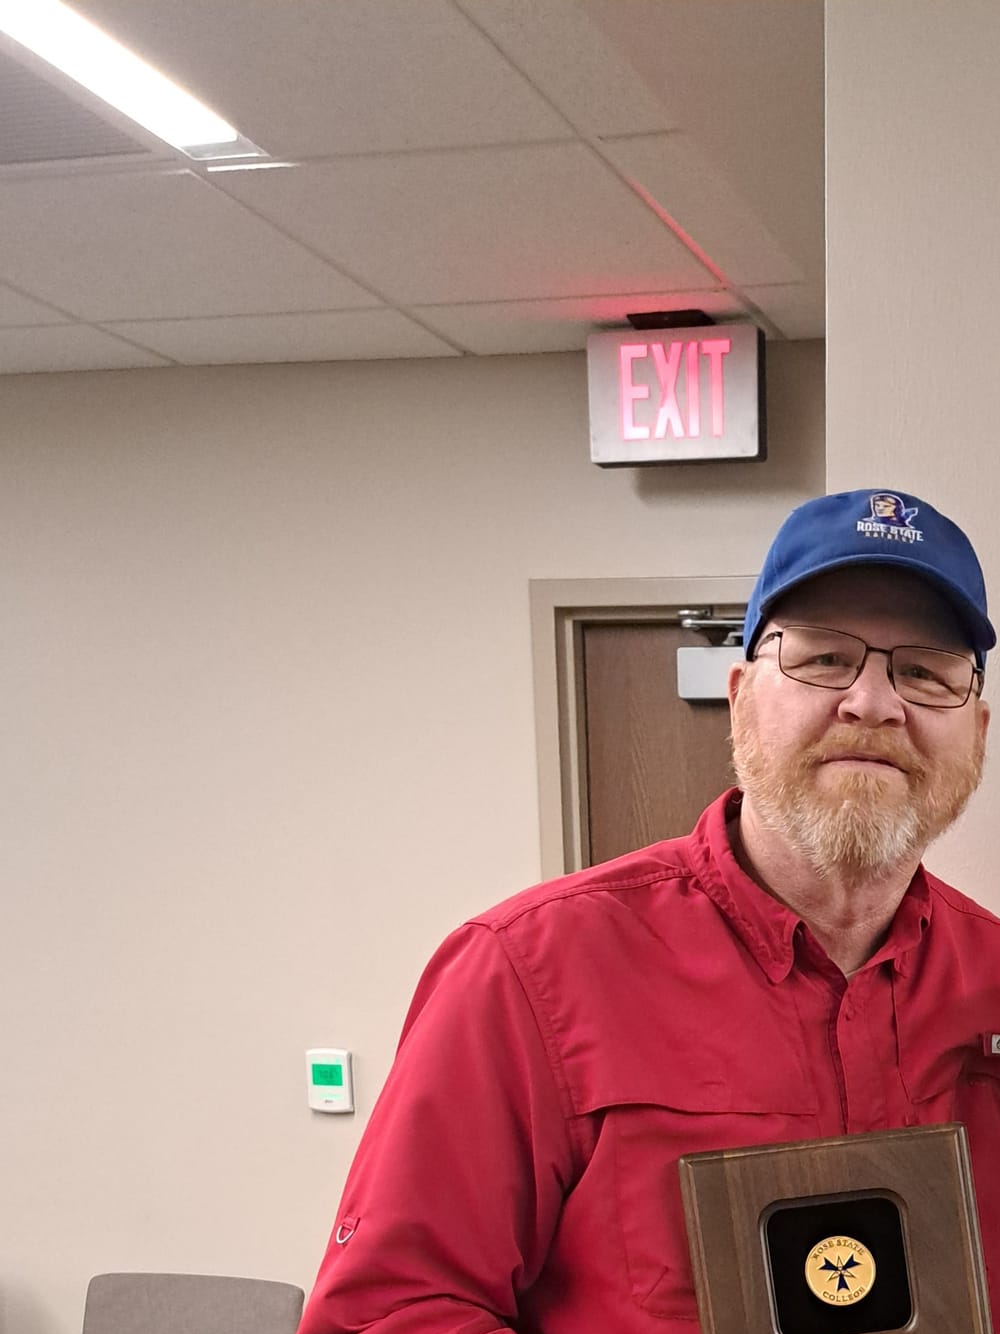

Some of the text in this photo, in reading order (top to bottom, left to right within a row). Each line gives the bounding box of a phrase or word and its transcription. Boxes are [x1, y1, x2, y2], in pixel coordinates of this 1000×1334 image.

[620, 339, 731, 440] EXIT
[856, 521, 925, 541] ROSE STATE
[811, 1239, 866, 1260] ROSE STATE
[822, 1286, 867, 1303] COLLEGE
